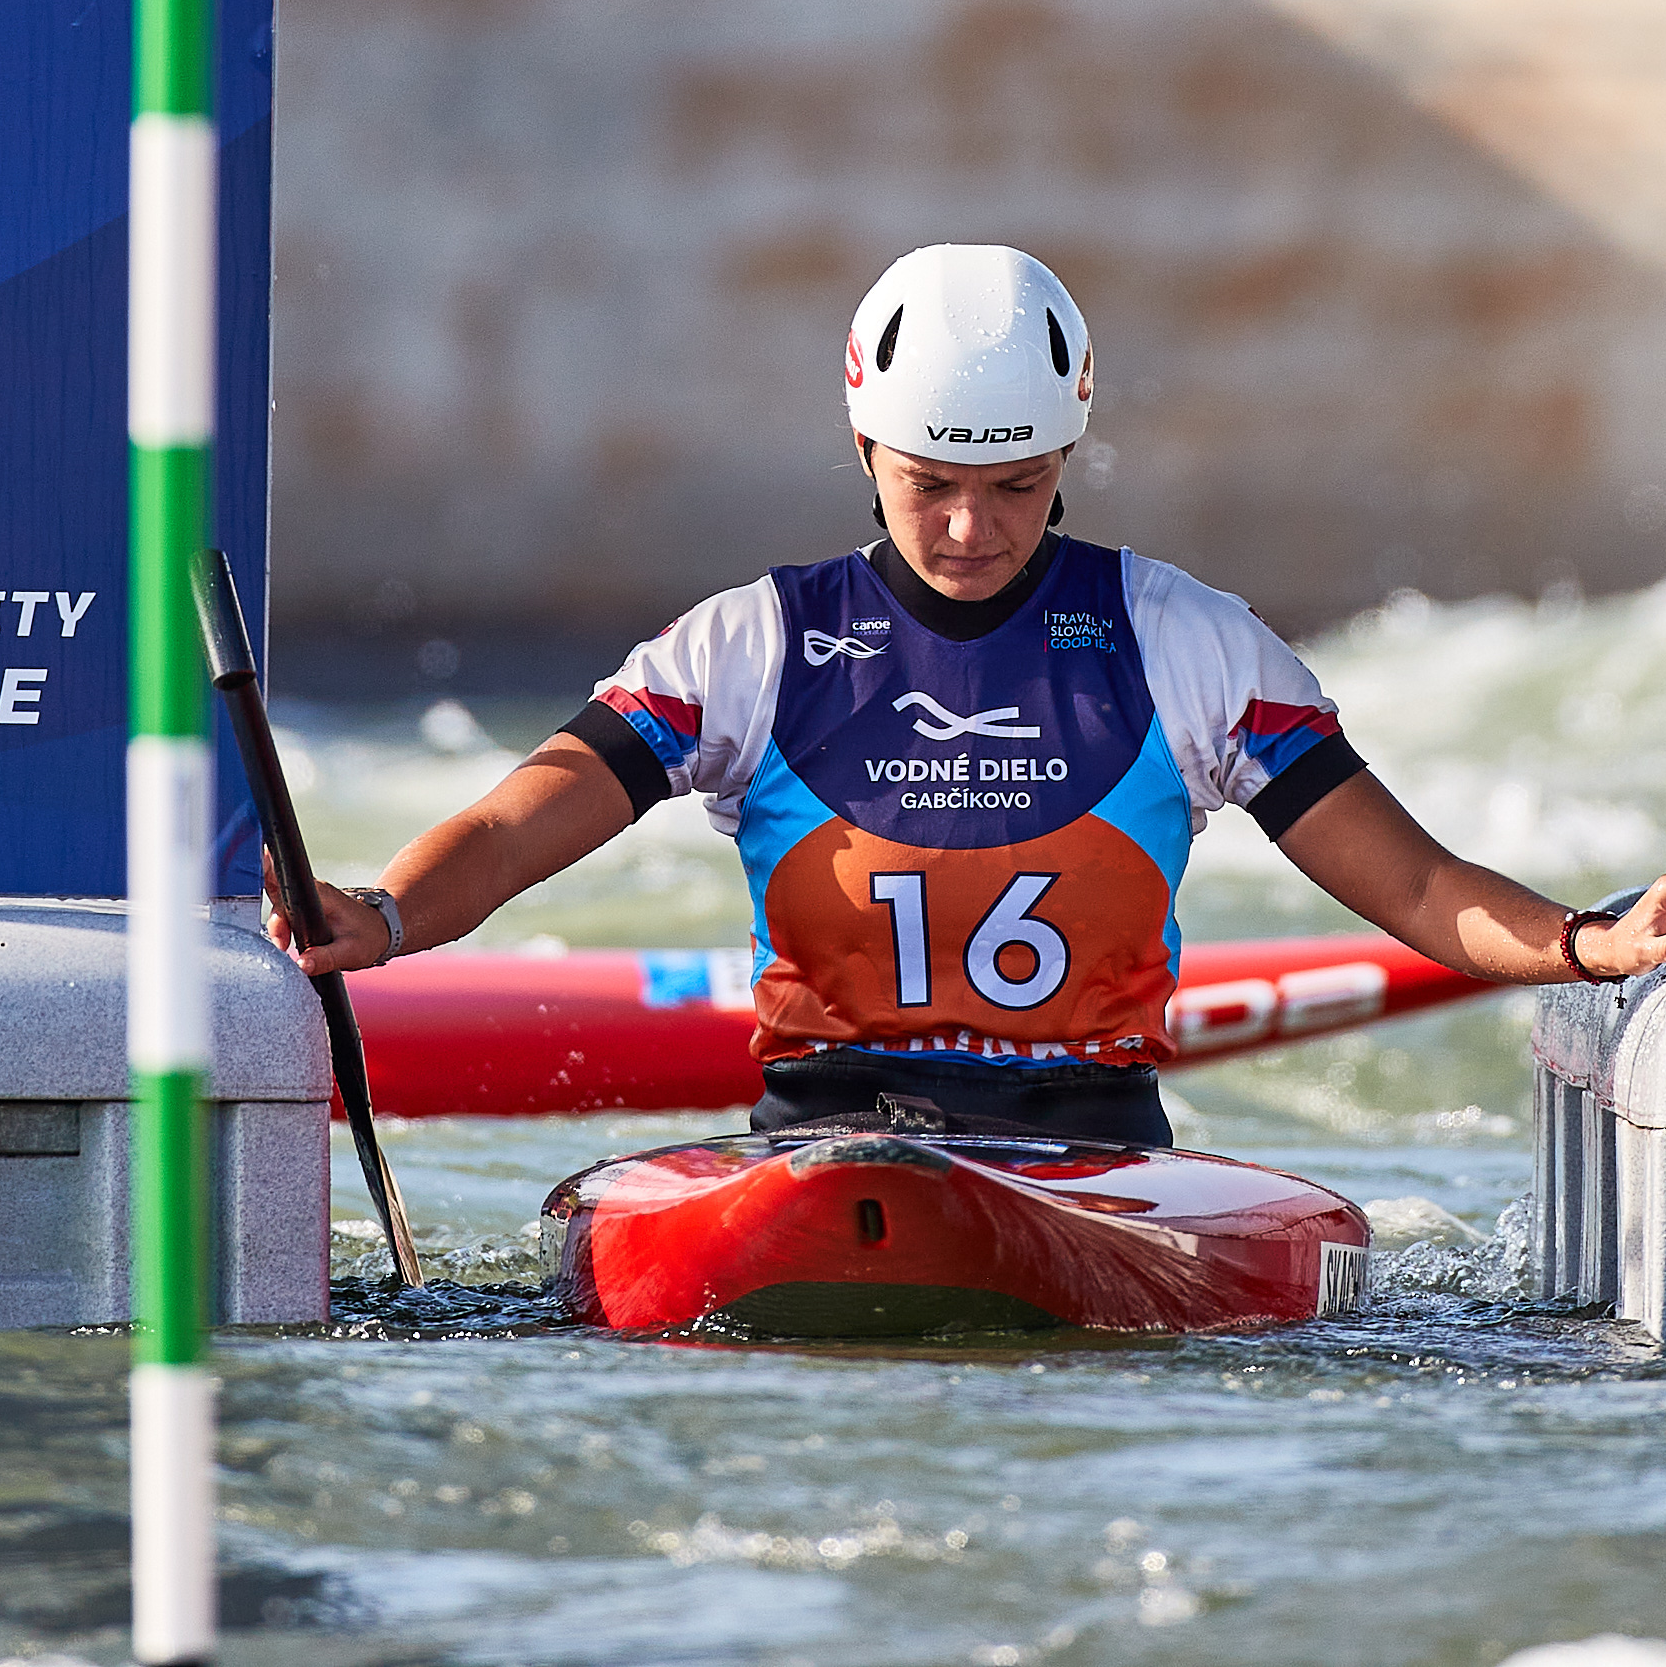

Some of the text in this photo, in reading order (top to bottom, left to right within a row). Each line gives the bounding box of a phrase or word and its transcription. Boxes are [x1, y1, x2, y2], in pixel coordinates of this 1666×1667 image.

[852, 620, 891, 631] canoe
[1051, 612, 1098, 626] TRAVEL
[1050, 622, 1106, 638] SLOVAKI
[1050, 636, 1092, 650] GOOD
[864, 752, 1068, 782] VODNÉ DIELO
[900, 787, 1031, 809] GABČÍKOVO
[871, 871, 1070, 1011] 16
